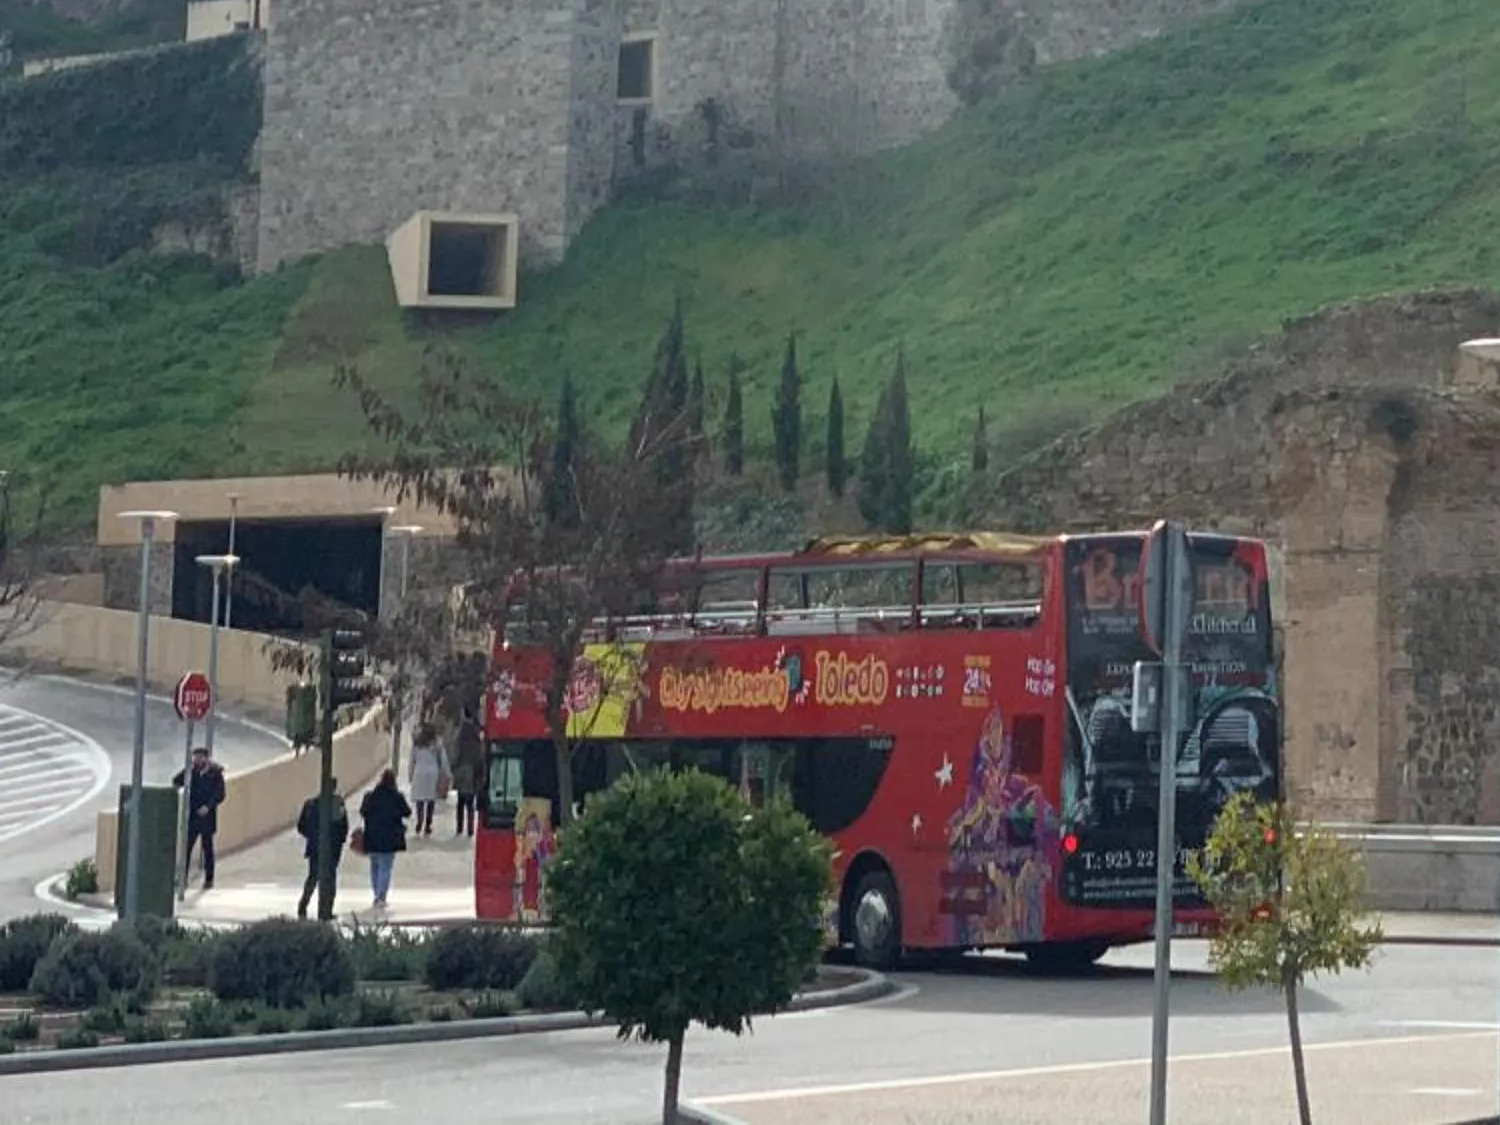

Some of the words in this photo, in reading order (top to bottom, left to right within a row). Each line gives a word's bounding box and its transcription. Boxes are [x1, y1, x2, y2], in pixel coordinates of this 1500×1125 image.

[815, 650, 889, 706] Toledo
[184, 690, 208, 704] STOP
[1105, 850, 1133, 870] 925
